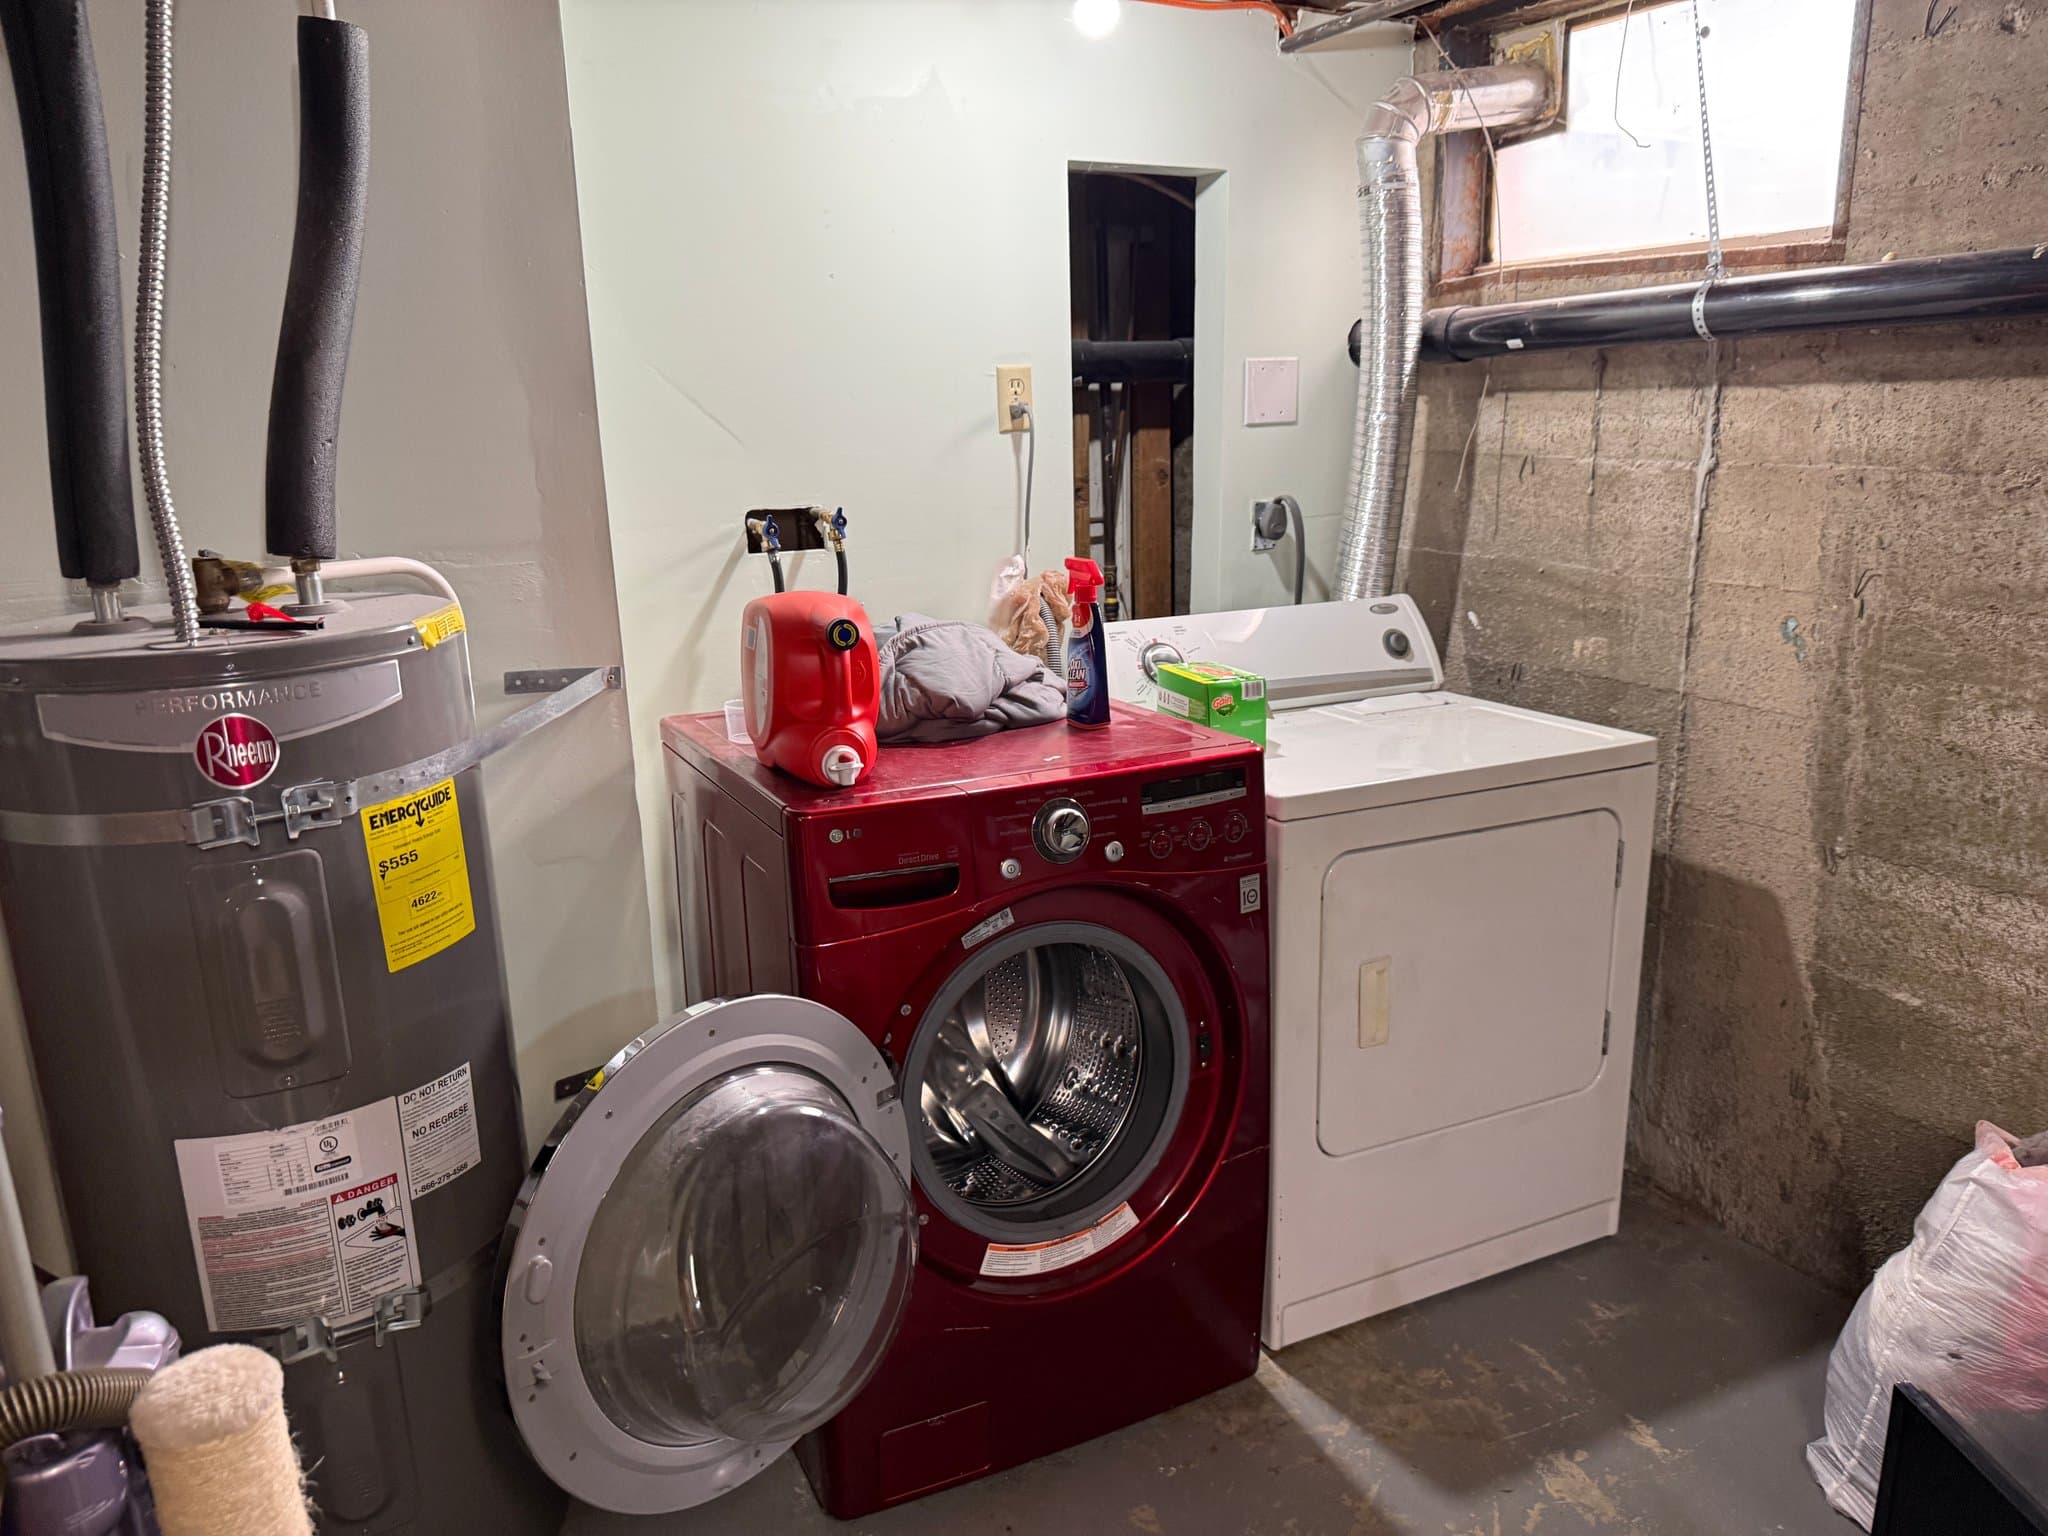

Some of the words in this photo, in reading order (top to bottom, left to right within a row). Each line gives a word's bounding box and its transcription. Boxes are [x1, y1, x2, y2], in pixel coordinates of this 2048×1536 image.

[135, 680, 322, 715] PERFORMANCE
[1212, 696, 1233, 709] Gain
[203, 718, 275, 778] Rheem
[369, 786, 451, 829] ENERGYGUIDE
[845, 828, 862, 840] LG
[378, 850, 419, 875] $555
[921, 853, 940, 863] Drive
[411, 890, 438, 909] 4622
[403, 1093, 417, 1105] DO
[419, 1084, 437, 1100] NOT
[438, 1067, 468, 1089] RETURN
[412, 1126, 427, 1139] NO
[429, 1103, 469, 1132] REGRESE
[348, 1176, 394, 1199] DANGER
